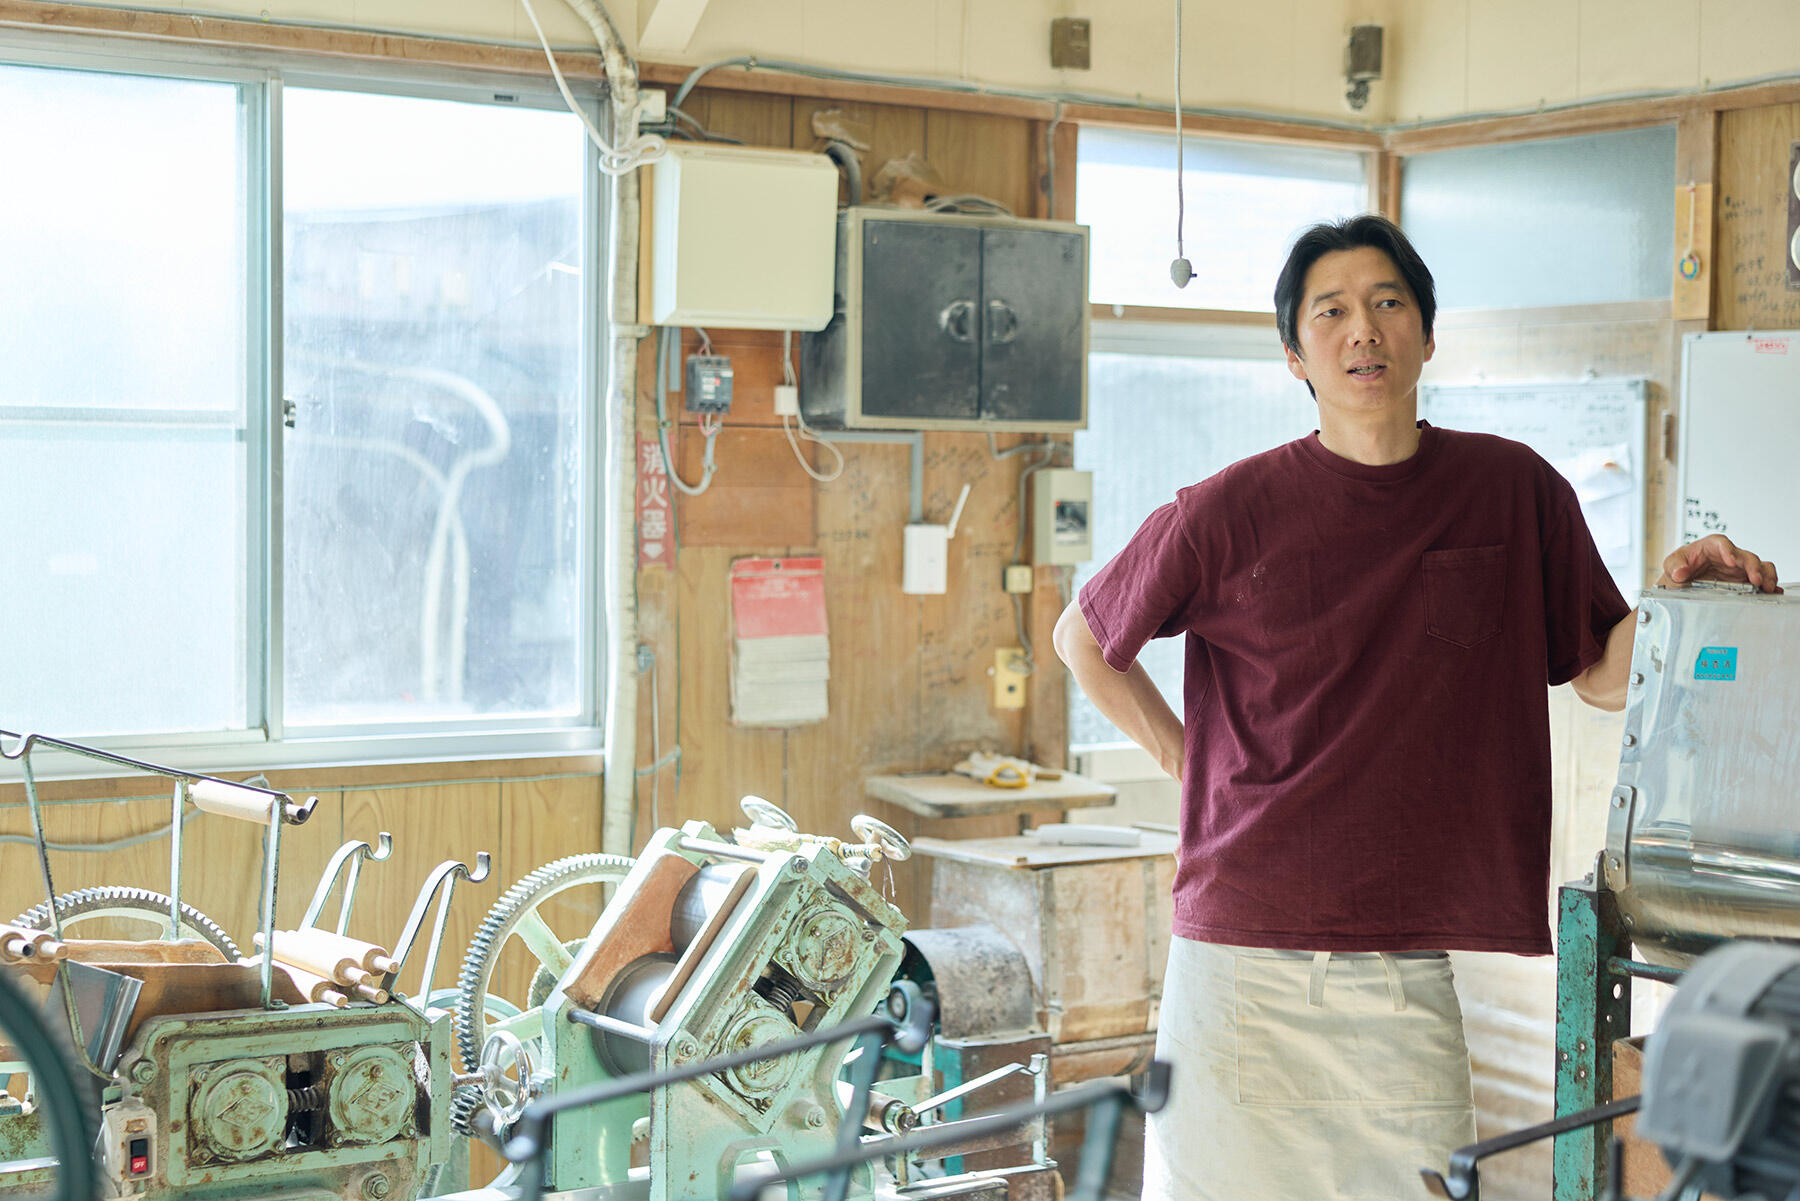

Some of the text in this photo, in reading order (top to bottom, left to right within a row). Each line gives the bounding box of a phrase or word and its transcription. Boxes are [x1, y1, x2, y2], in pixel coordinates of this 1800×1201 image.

[642, 443, 667, 540] 消火器
[133, 1161, 145, 1169] OFF
